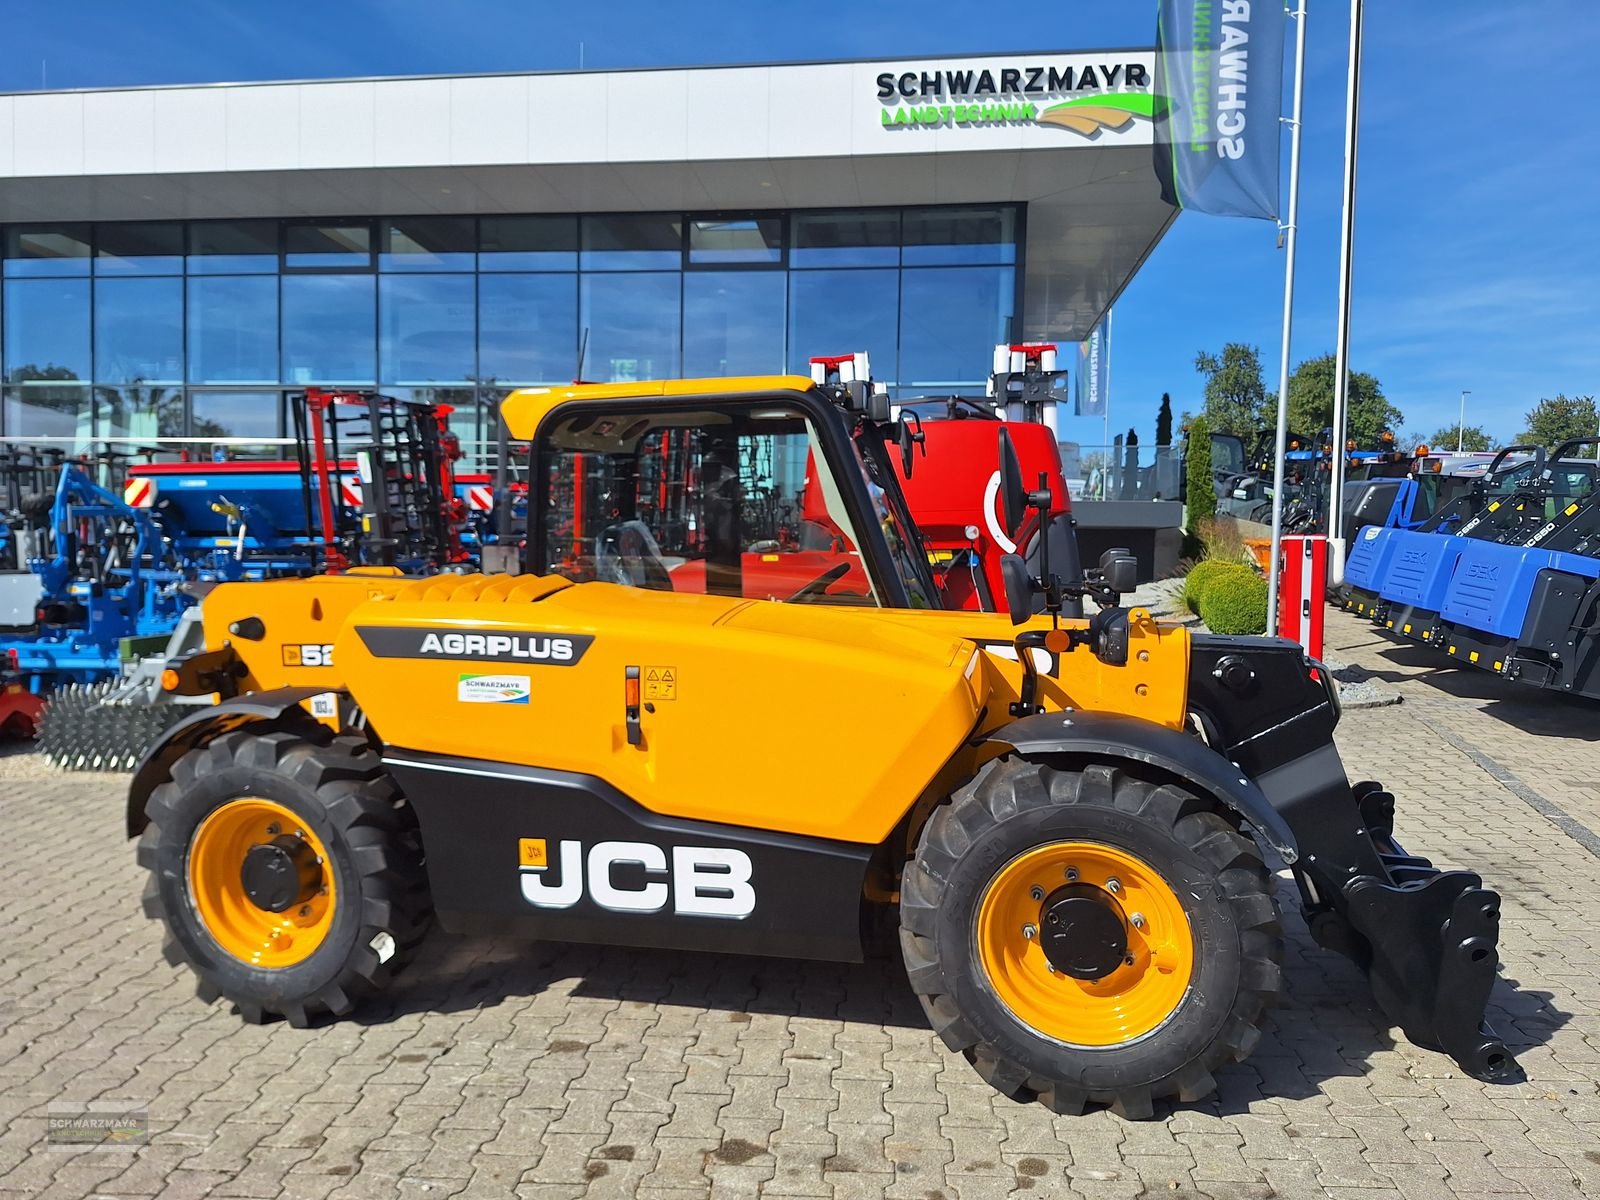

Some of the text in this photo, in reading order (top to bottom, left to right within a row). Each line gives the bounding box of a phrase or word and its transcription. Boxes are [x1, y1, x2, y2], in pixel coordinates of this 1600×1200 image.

[876, 63, 1146, 98] SCHWARZMAYR
[881, 103, 1037, 126] LANDTECHNIK
[518, 838, 757, 920] JCB
